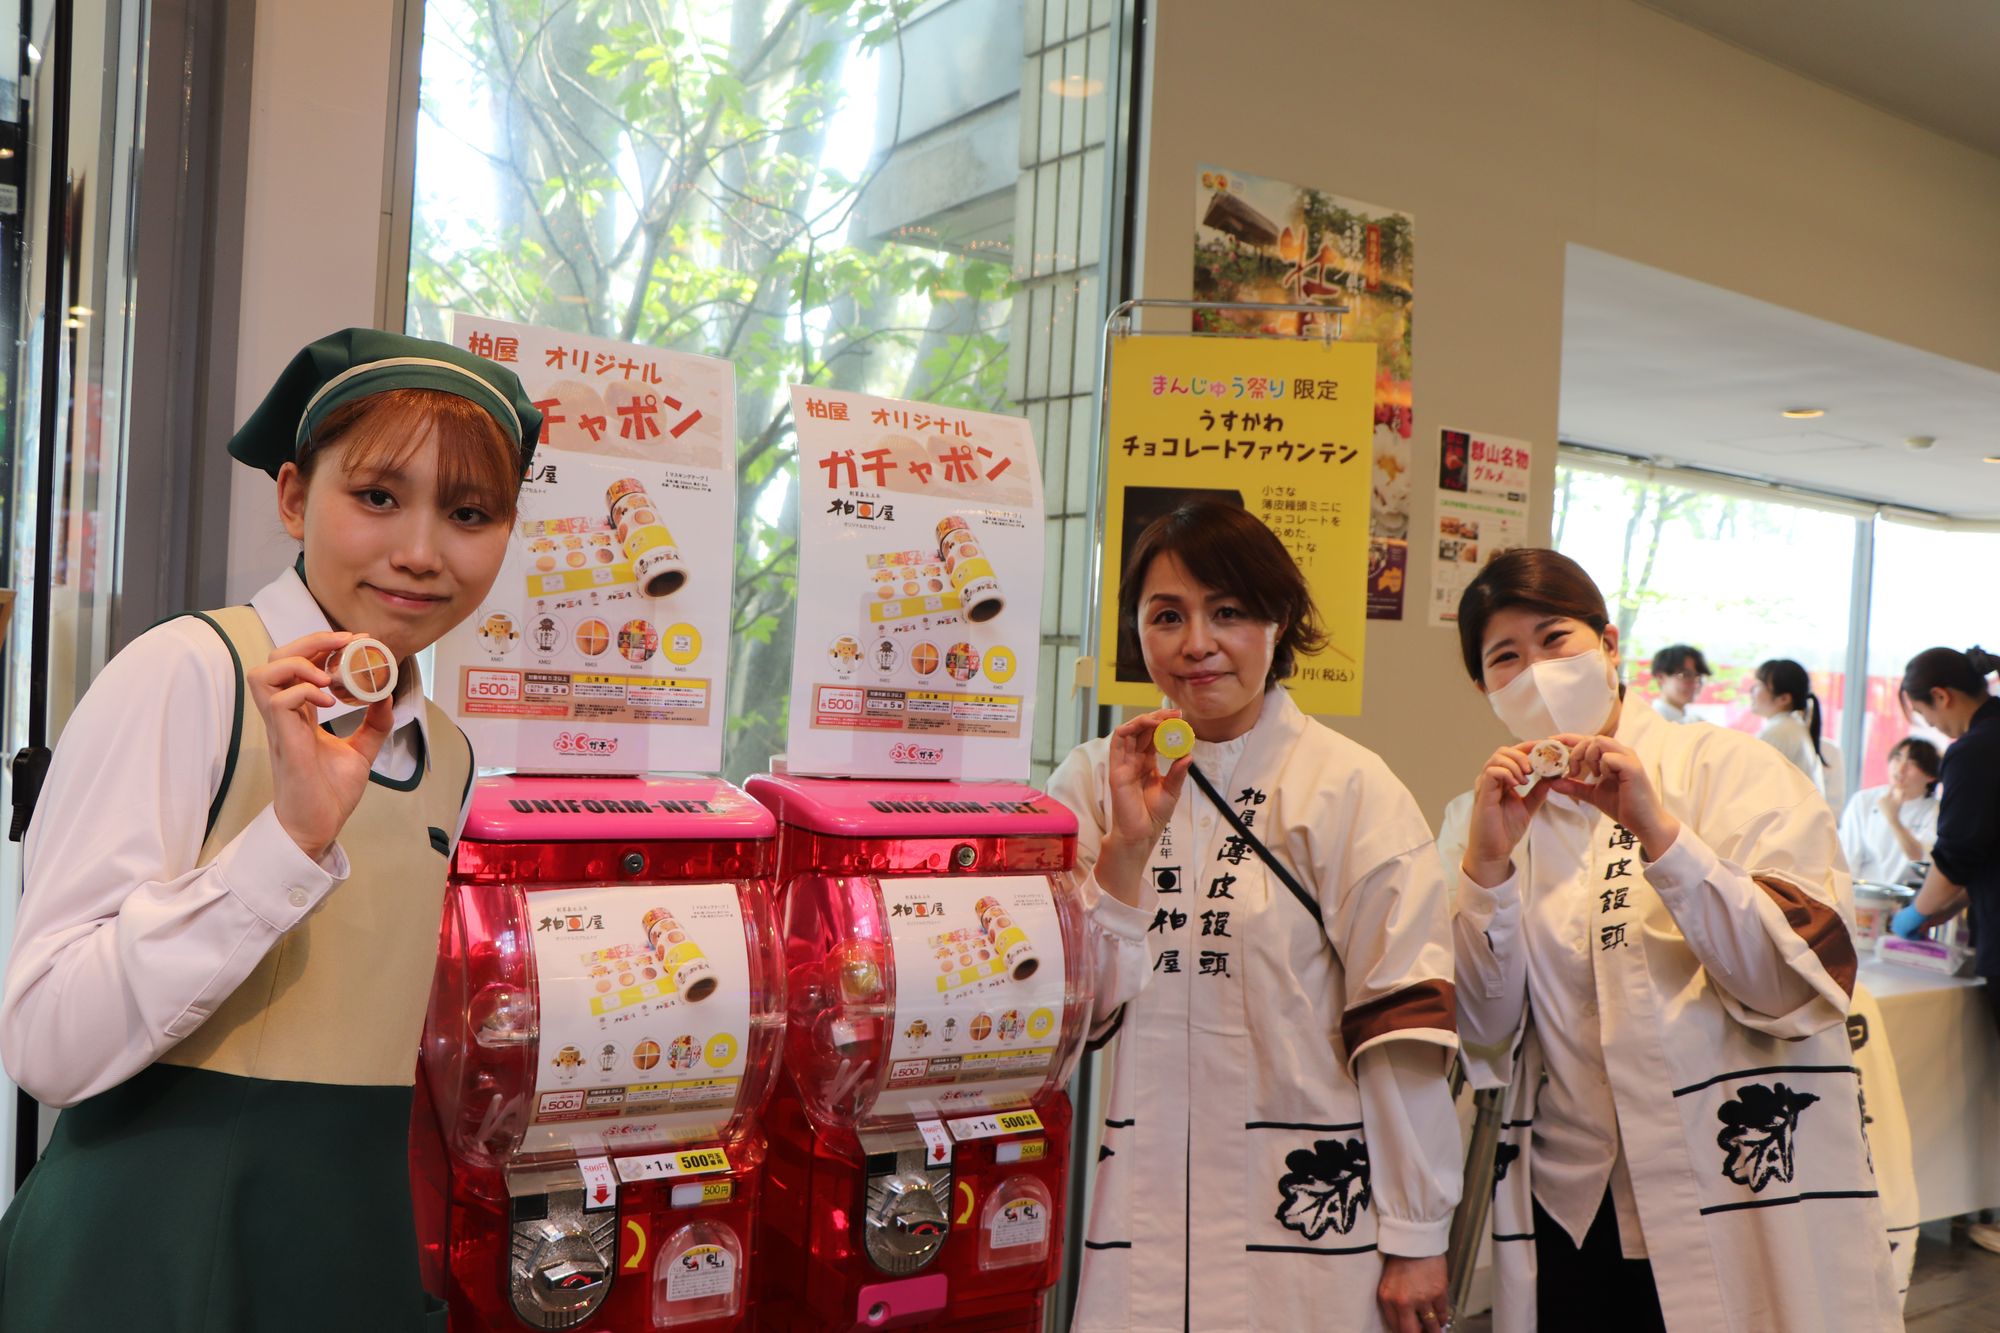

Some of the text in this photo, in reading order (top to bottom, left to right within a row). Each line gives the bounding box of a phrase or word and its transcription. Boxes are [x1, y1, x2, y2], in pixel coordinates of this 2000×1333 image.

[468, 331, 663, 385] 柏屋 オリジナル
[1152, 375, 1339, 400] まんじゅう祭り 限定
[532, 394, 703, 445] チャポン
[806, 398, 973, 438] 柏屋 オリジナル
[1200, 410, 1284, 432] うすかわ
[1122, 435, 1359, 464] チョコレートファウンテン
[818, 444, 1012, 490] ガチャポン
[1262, 485, 1296, 497] 小さな
[826, 498, 896, 522] 柏屋
[1262, 512, 1341, 527] チョコレートを
[1284, 542, 1317, 553] ートな
[1147, 907, 1188, 974] 柏屋
[704, 1184, 729, 1196] 500円
